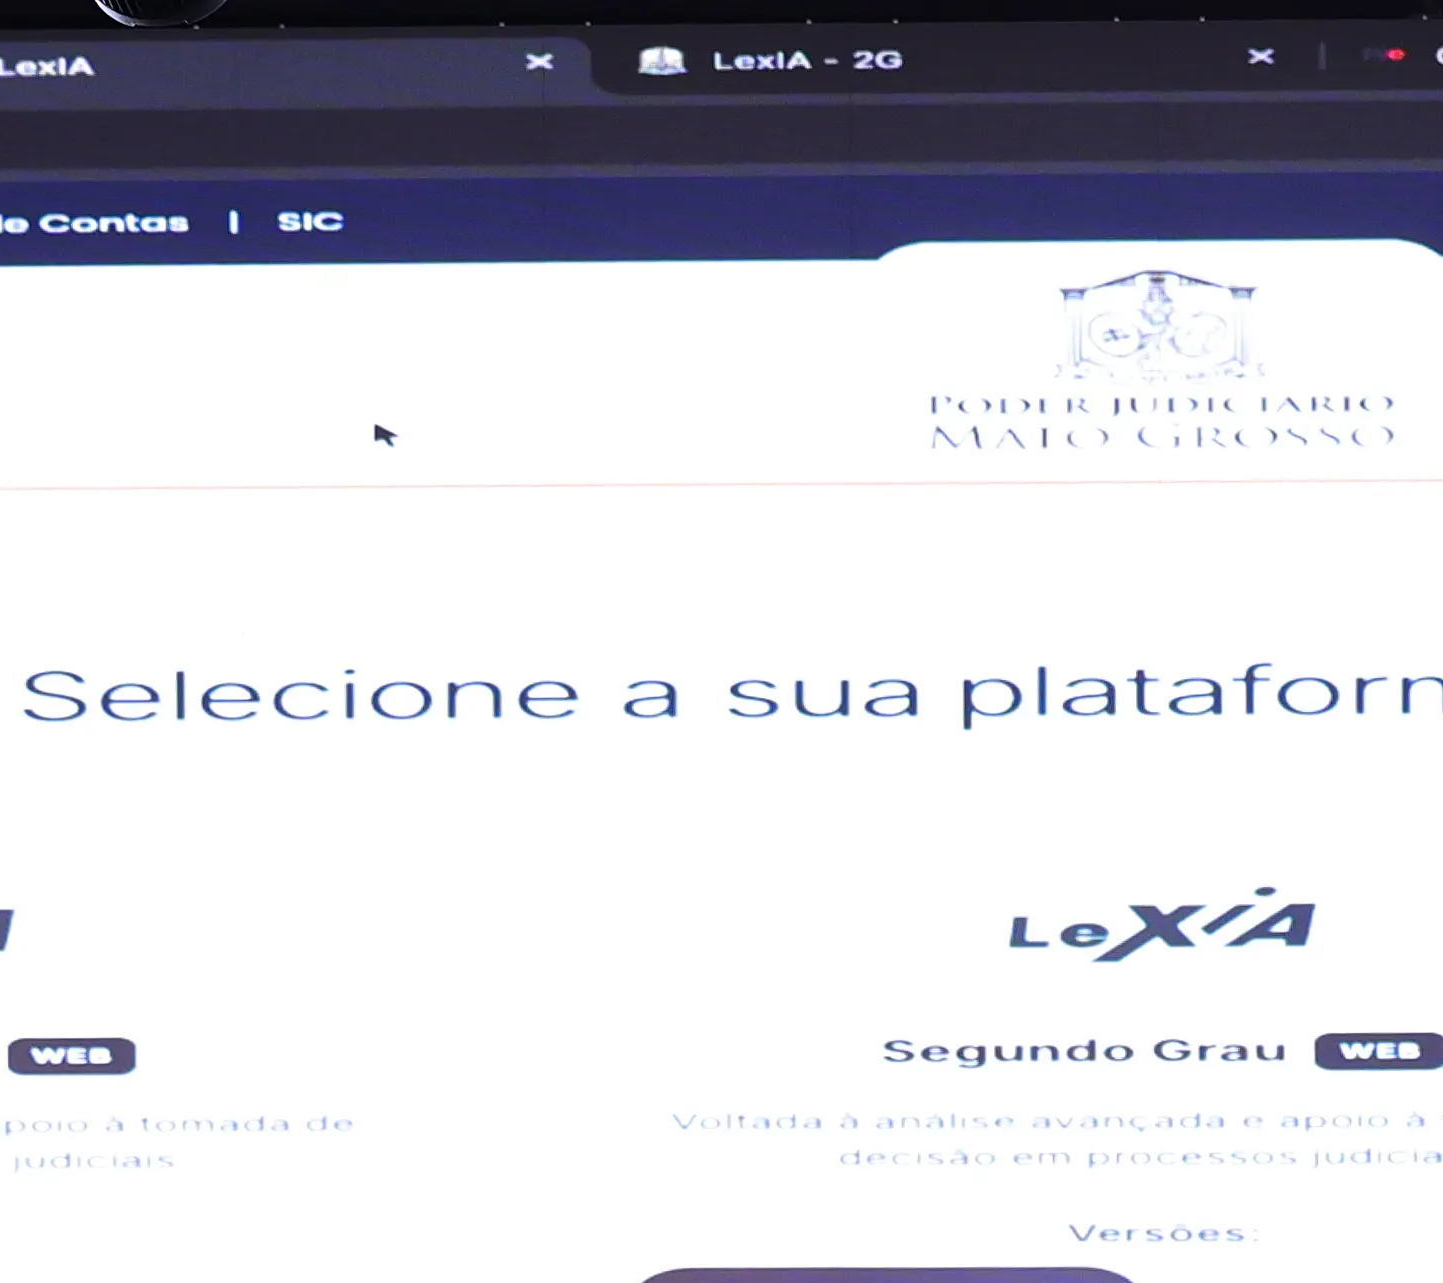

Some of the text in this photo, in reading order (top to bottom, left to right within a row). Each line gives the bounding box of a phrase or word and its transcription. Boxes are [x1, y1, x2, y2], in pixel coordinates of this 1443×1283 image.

[853, 50, 902, 69] 2G
[38, 213, 189, 234] Contas
[278, 212, 344, 231] SIC
[24, 669, 578, 722] Selecione
[624, 681, 677, 718] a
[729, 679, 918, 718] sua
[30, 1047, 112, 1064] WEB
[884, 1039, 1284, 1068] Segundo Grau
[1339, 1042, 1420, 1059] WEB
[142, 1116, 289, 1131] tomada
[307, 1116, 353, 1131] de
[673, 1114, 821, 1129] Voltada
[876, 1113, 1014, 1129] análise
[1033, 1113, 1224, 1132] avançada
[1243, 1117, 1263, 1127] e
[1281, 1116, 1388, 1131] apoio
[840, 1150, 996, 1165] decisão
[1013, 1152, 1070, 1165] em
[1088, 1152, 1296, 1168] processos
